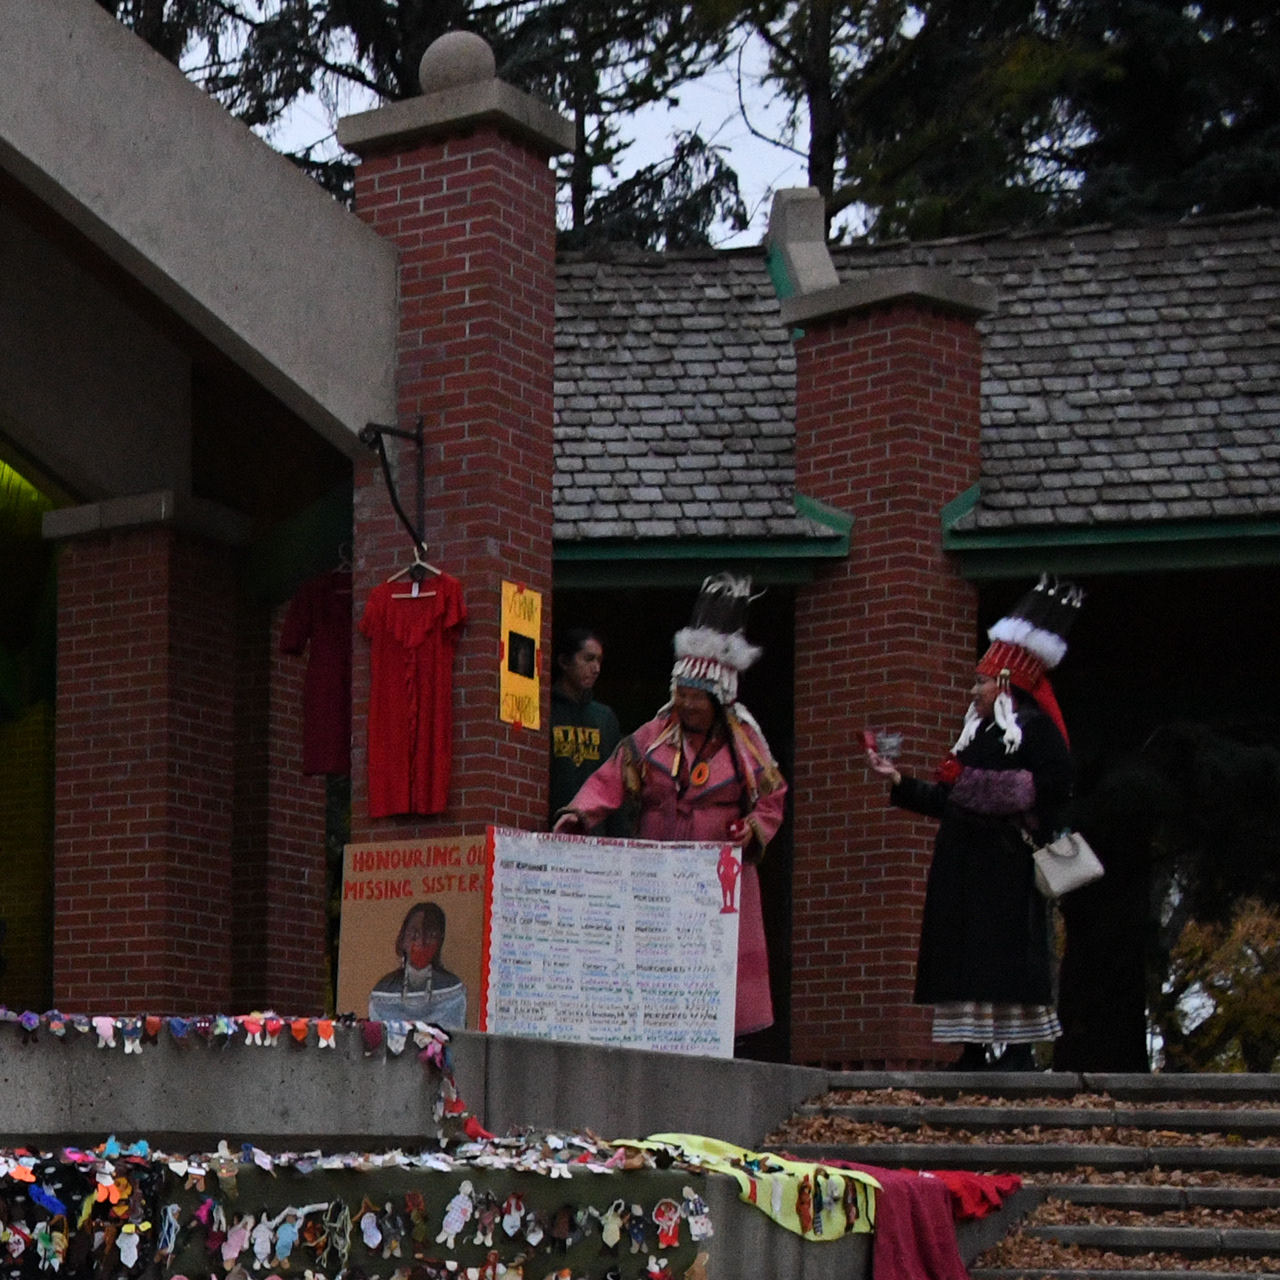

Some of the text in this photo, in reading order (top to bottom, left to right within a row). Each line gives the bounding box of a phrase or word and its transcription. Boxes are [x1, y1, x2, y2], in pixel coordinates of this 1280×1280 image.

[352, 846, 462, 872] HONOURING
[466, 844, 487, 866] OU
[343, 879, 414, 901] MISSING
[421, 872, 485, 894] SISTER
